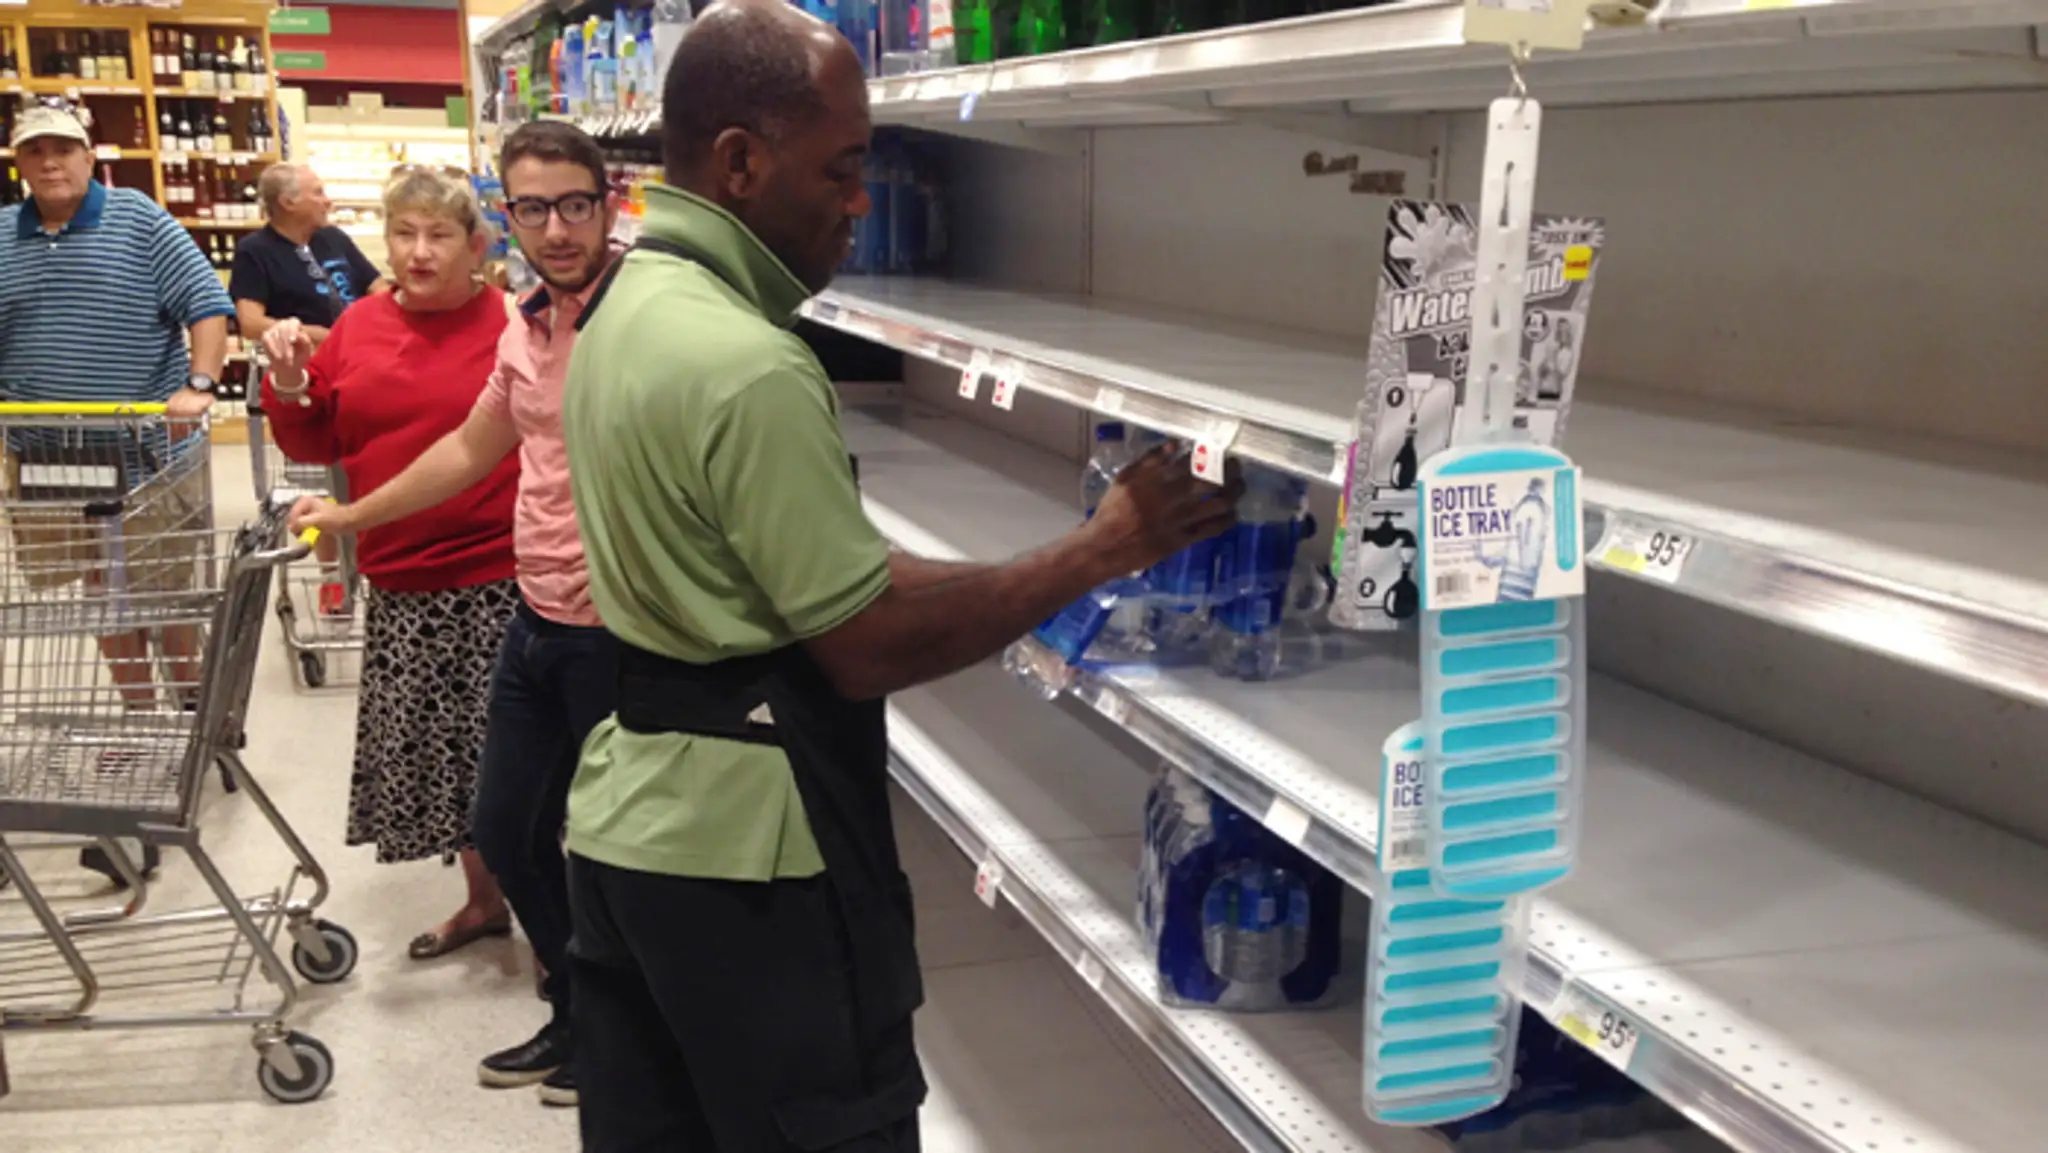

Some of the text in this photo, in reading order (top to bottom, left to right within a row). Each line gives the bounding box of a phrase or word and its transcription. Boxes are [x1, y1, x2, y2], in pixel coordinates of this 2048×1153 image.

[1431, 483, 1497, 513] BOTTLE
[1433, 509, 1511, 538] ICE TRAY
[1395, 760, 1422, 785] BO
[1393, 784, 1424, 808] ICE
